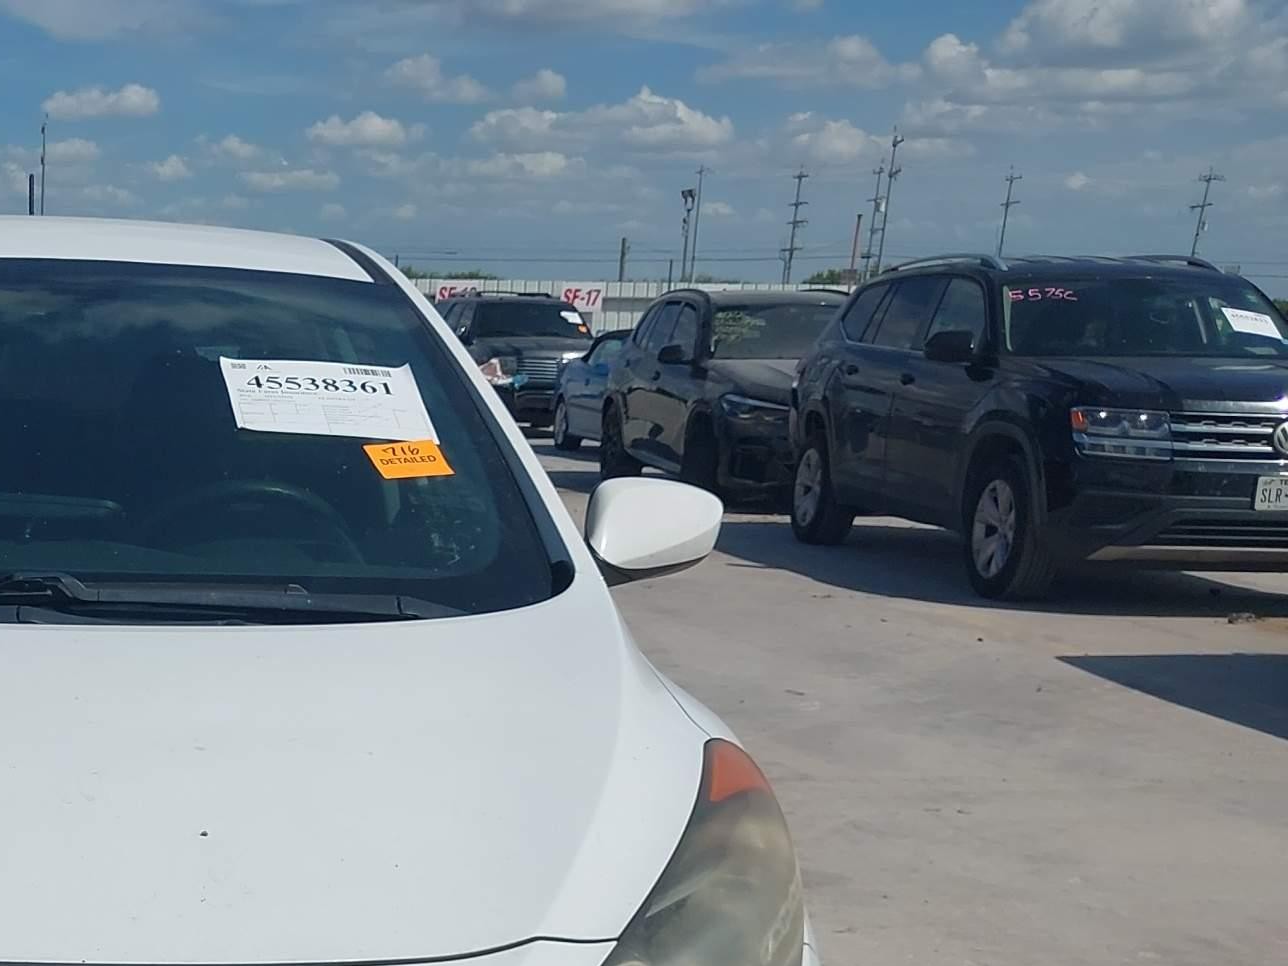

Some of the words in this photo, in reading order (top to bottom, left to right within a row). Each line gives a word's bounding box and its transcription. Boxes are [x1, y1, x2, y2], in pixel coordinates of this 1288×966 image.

[564, 288, 601, 306] SF-17
[247, 375, 393, 396] 45538361
[379, 454, 437, 466] DETAILED
